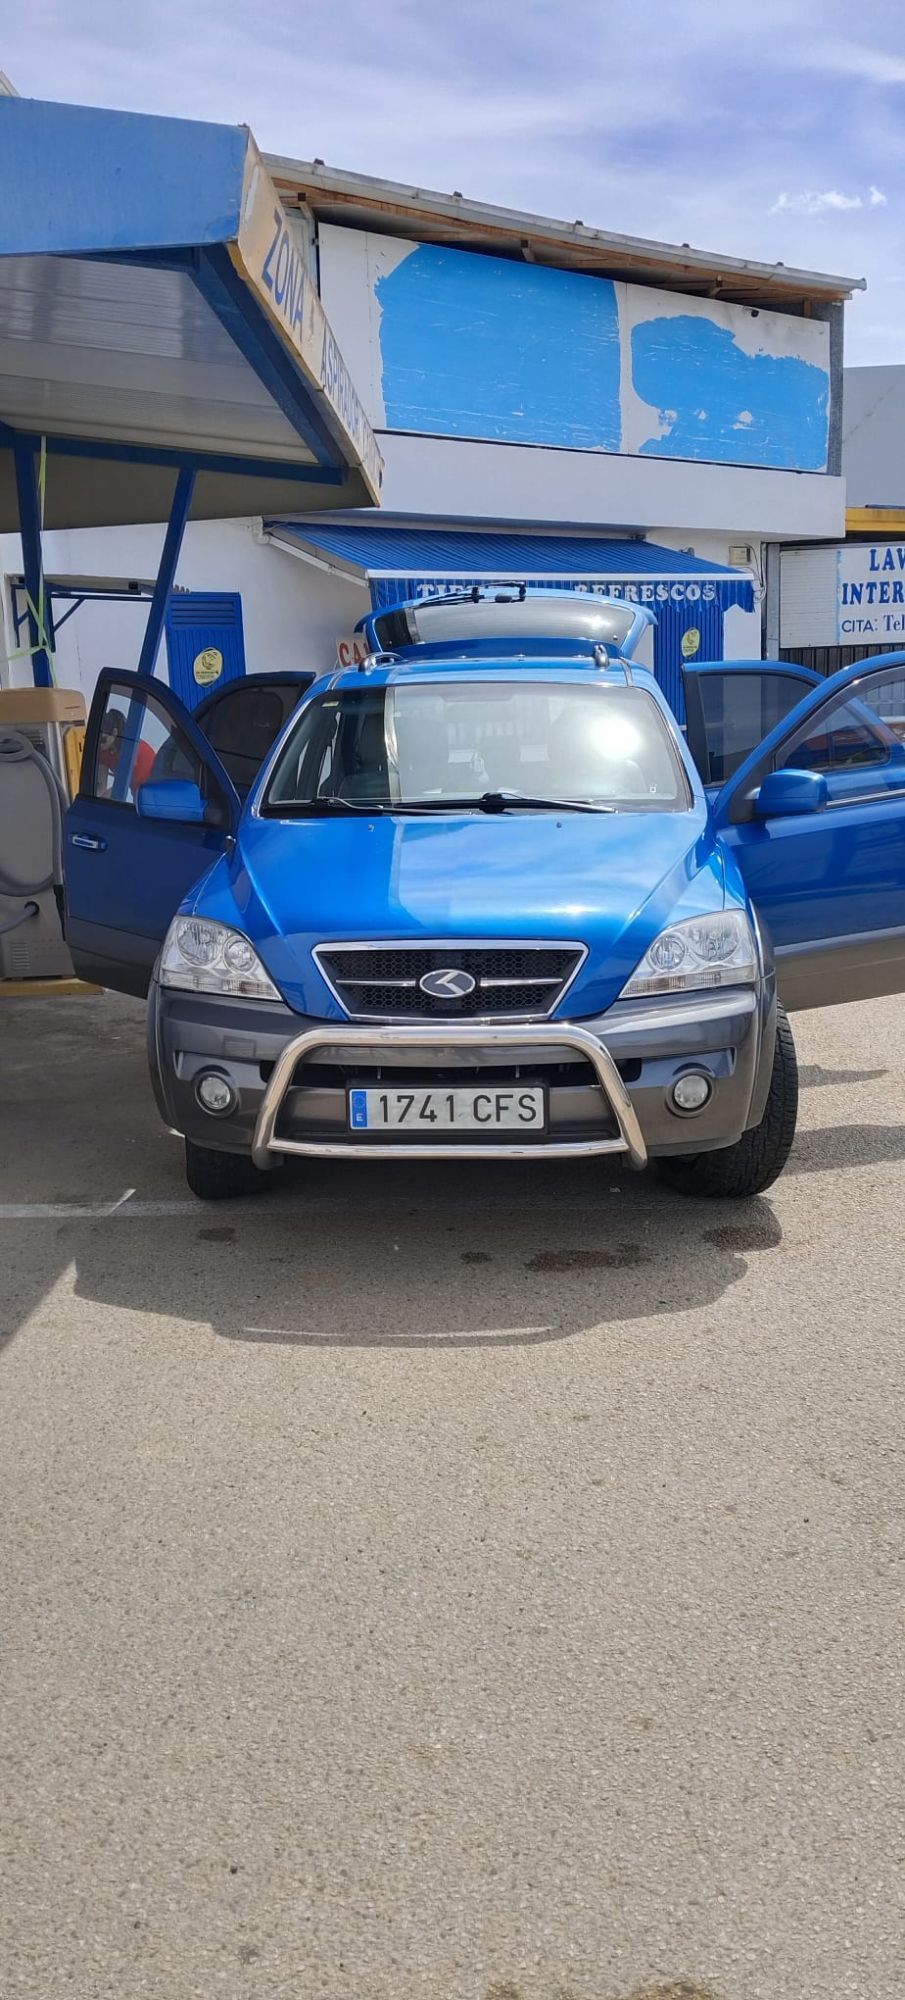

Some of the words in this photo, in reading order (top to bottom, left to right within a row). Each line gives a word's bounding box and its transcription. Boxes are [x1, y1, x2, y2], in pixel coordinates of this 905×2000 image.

[261, 208, 303, 341] ZONA
[841, 581, 905, 605] INTER
[841, 619, 878, 632] CITA:
[356, 1113, 364, 1122] E
[379, 1094, 455, 1123] 1741
[473, 1094, 537, 1123] CFS
